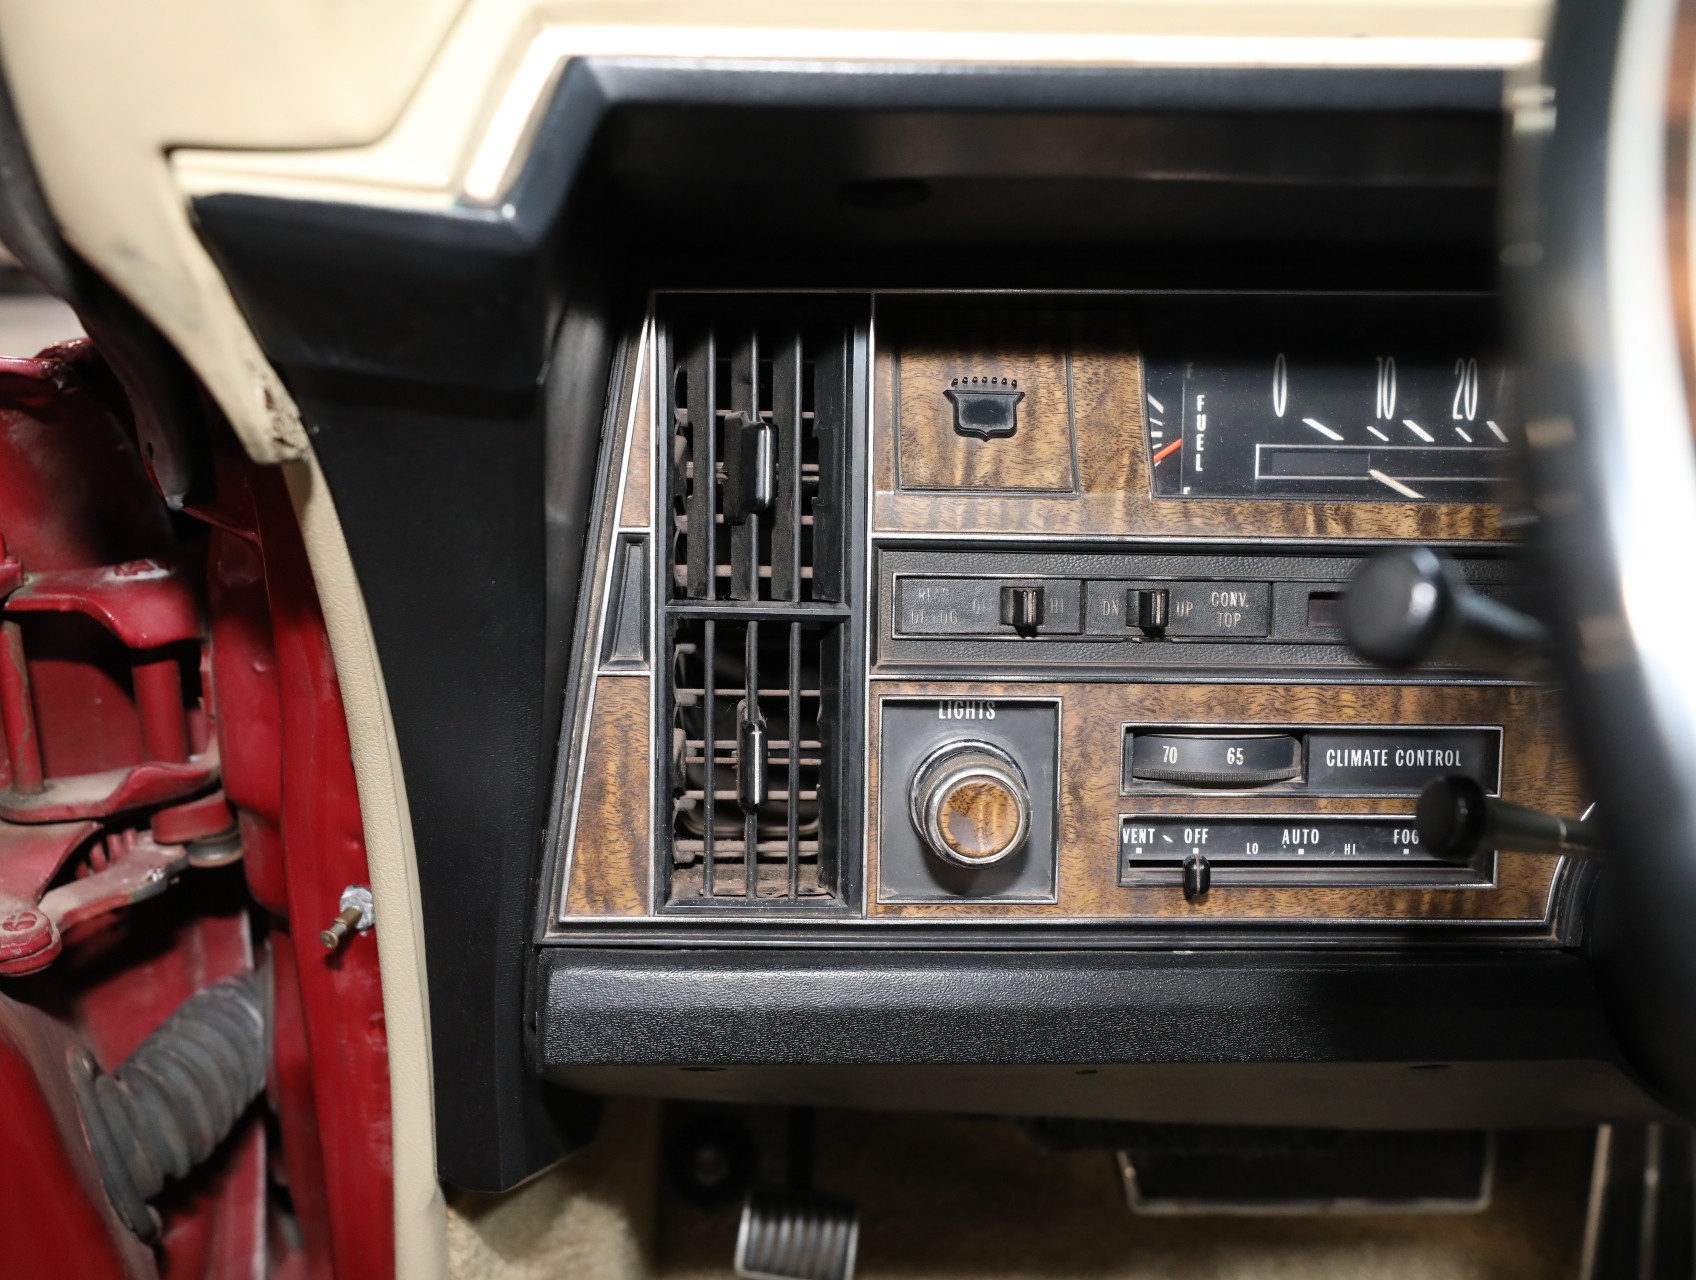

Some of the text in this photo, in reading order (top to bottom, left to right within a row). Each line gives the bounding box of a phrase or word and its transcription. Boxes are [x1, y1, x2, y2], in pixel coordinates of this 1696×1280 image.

[1272, 352, 1287, 418] 0
[1375, 355, 1397, 420] 10
[1452, 357, 1478, 421] 20
[1195, 394, 1207, 472] FUEL
[1211, 591, 1249, 608] CONV.
[1176, 601, 1193, 617] UP
[1219, 612, 1242, 627] TOP
[938, 700, 996, 720] LIGHTS
[1162, 745, 1244, 766] 70 65
[1326, 749, 1462, 767] CLIMATE CONTROL
[1121, 827, 1419, 845] VENT OFF AUTO FOG
[1246, 842, 1259, 855] LO
[1344, 843, 1357, 855] HI
